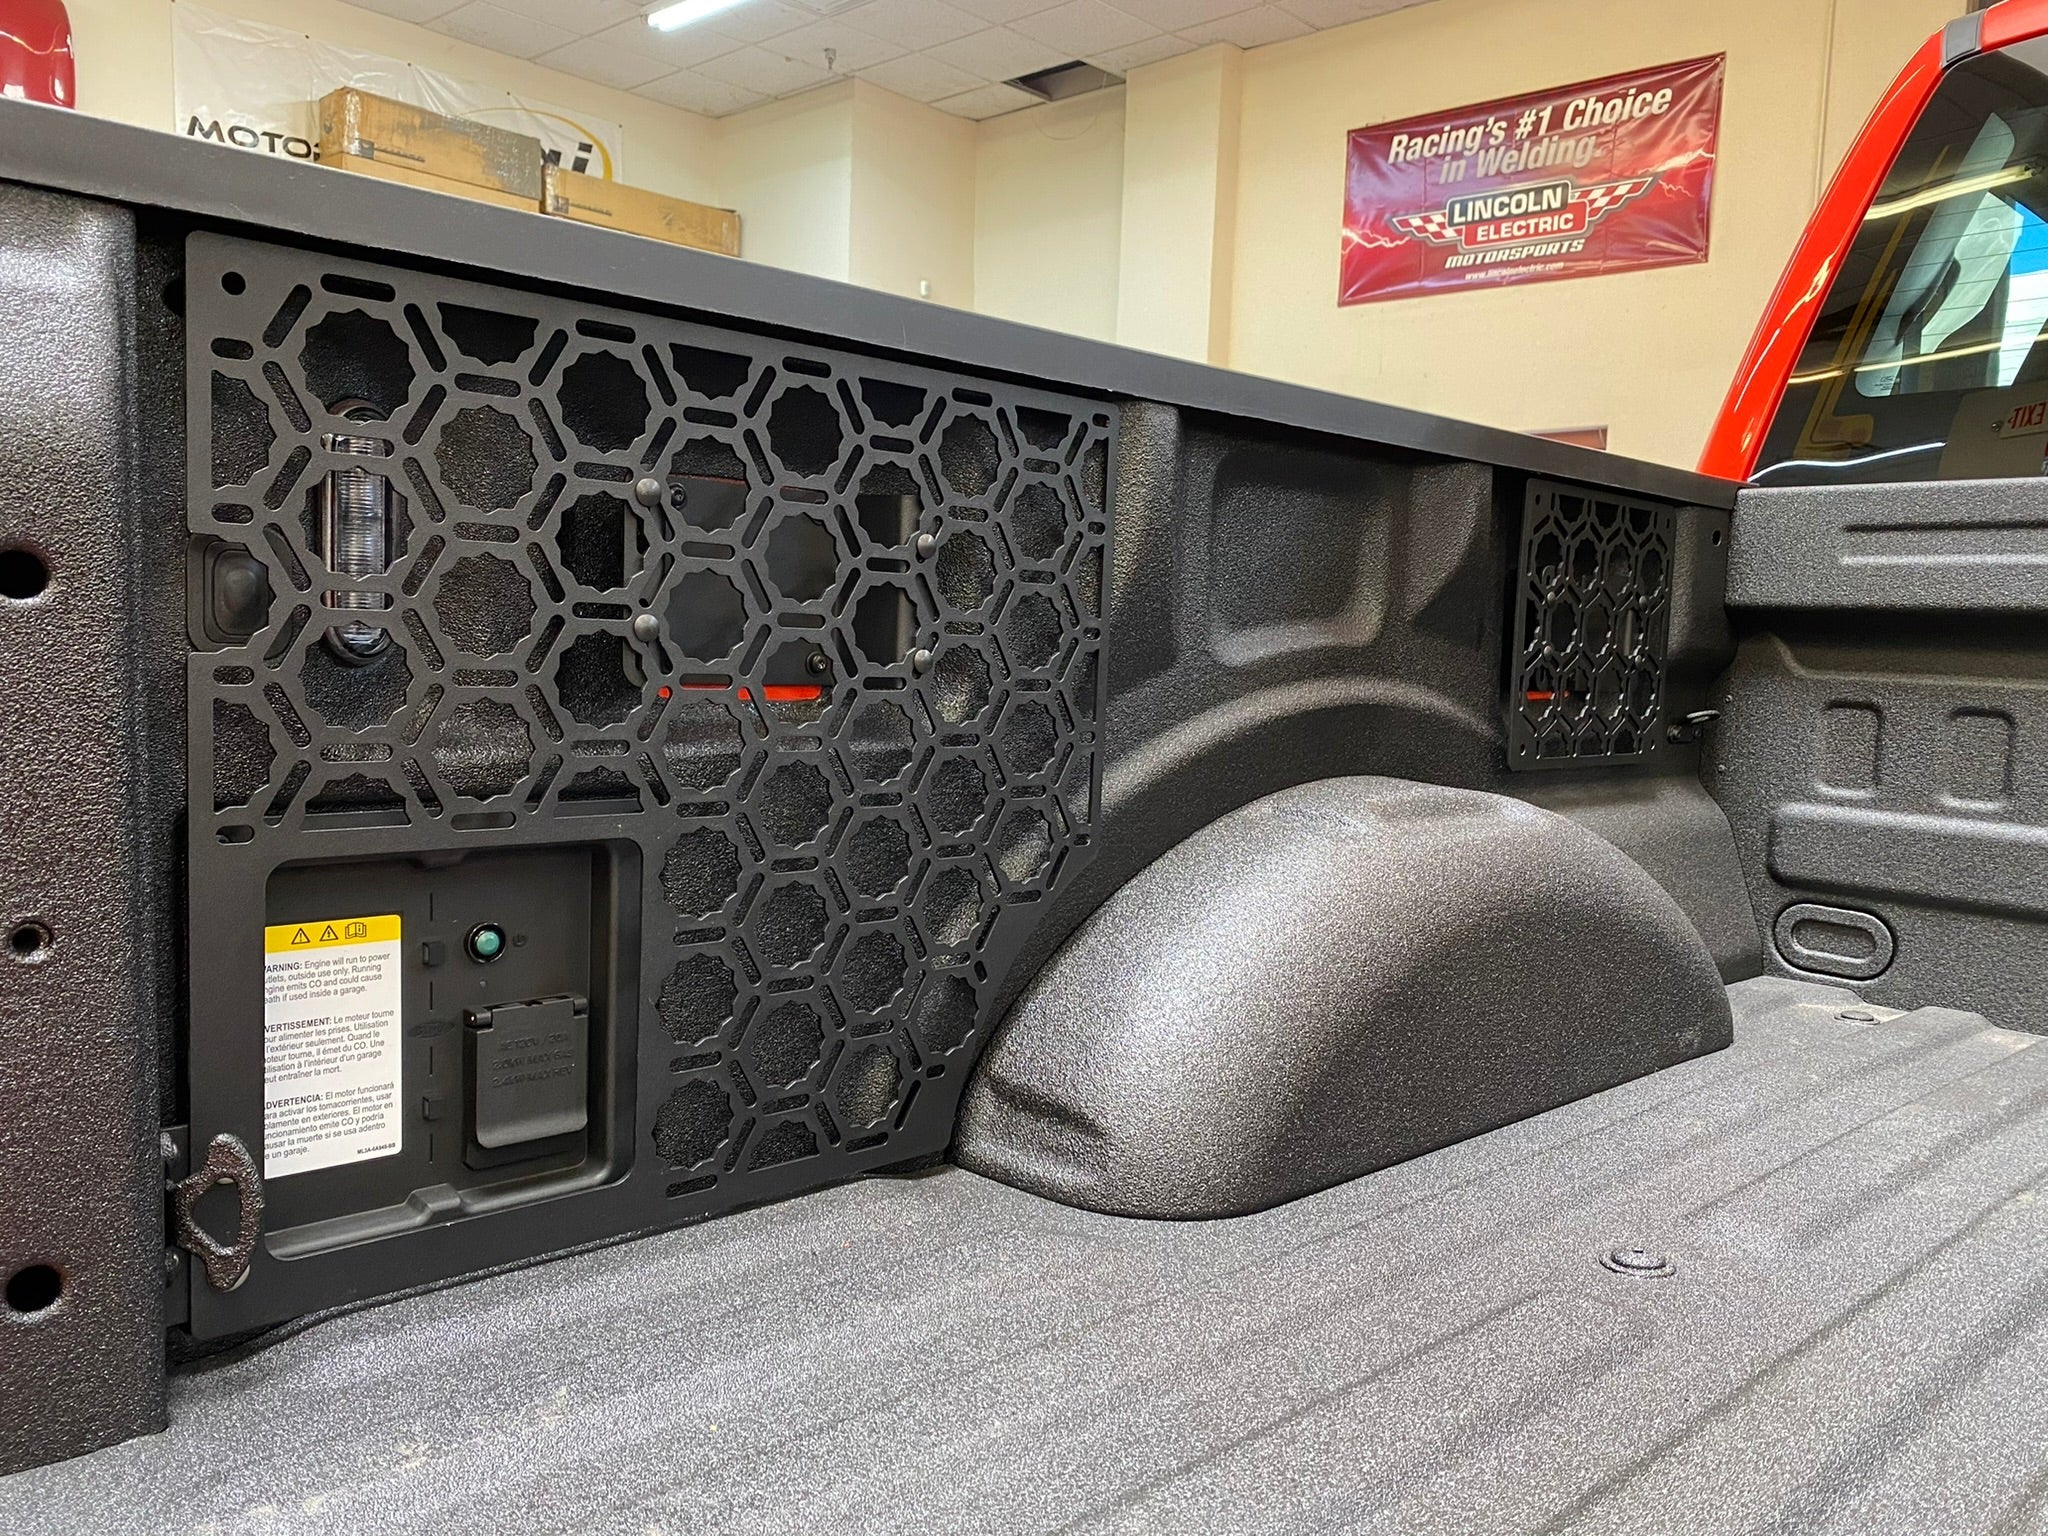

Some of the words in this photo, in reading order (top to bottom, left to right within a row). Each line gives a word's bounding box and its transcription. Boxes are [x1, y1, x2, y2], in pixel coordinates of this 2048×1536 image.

[1388, 116, 1507, 164] Racing's
[1515, 105, 1554, 141] #1
[1563, 87, 1673, 133] Choice
[1439, 157, 1466, 185] in
[1452, 186, 1563, 225] LINCOLN
[1476, 212, 1574, 242] ELECTRIC
[1445, 238, 1585, 269] MOTORSPORTS
[264, 962, 302, 973] ARNING:
[305, 959, 330, 970] Engine
[332, 957, 344, 966] will
[368, 953, 390, 962] power
[288, 971, 316, 981] outside
[333, 967, 350, 976] only.
[352, 964, 382, 974] Running
[287, 982, 307, 991] emits
[309, 980, 322, 988] CO
[324, 978, 338, 986] and
[340, 975, 358, 984] could
[282, 993, 288, 1001] if
[289, 991, 307, 1001] used
[309, 988, 332, 998] inside
[340, 986, 367, 996] garage.
[264, 1018, 332, 1032] VERTISSEMENT:
[333, 1016, 343, 1024] Le
[345, 1013, 370, 1023] moteur
[278, 1030, 313, 1042] alimenter
[315, 1028, 326, 1036] les
[328, 1025, 352, 1036] prises.
[354, 1020, 388, 1031] Utilisation
[305, 1036, 345, 1048] seulement.
[348, 1032, 372, 1042] Quand
[373, 1030, 380, 1038] le
[264, 1054, 286, 1064] oteur
[342, 1044, 352, 1052] du
[370, 1040, 385, 1048] Une
[357, 1050, 382, 1060] garage
[314, 1067, 321, 1075] la
[323, 1065, 342, 1074] mort.
[264, 1094, 323, 1110] DVERTENCIA:
[326, 1092, 333, 1100] El
[335, 1089, 356, 1098] motor
[279, 1108, 304, 1118] activar
[306, 1105, 318, 1114] los
[376, 1092, 392, 1100] usar
[301, 1116, 311, 1124] en
[312, 1110, 350, 1122] exteriores.
[353, 1107, 360, 1115] El
[362, 1104, 382, 1114] motor
[319, 1121, 339, 1130] emite
[341, 1117, 353, 1126] CO
[296, 1133, 323, 1144] muerte
[344, 1127, 357, 1135] usa
[358, 1122, 386, 1133] adentro
[272, 1150, 282, 1159] un
[284, 1146, 310, 1158] garaje.
